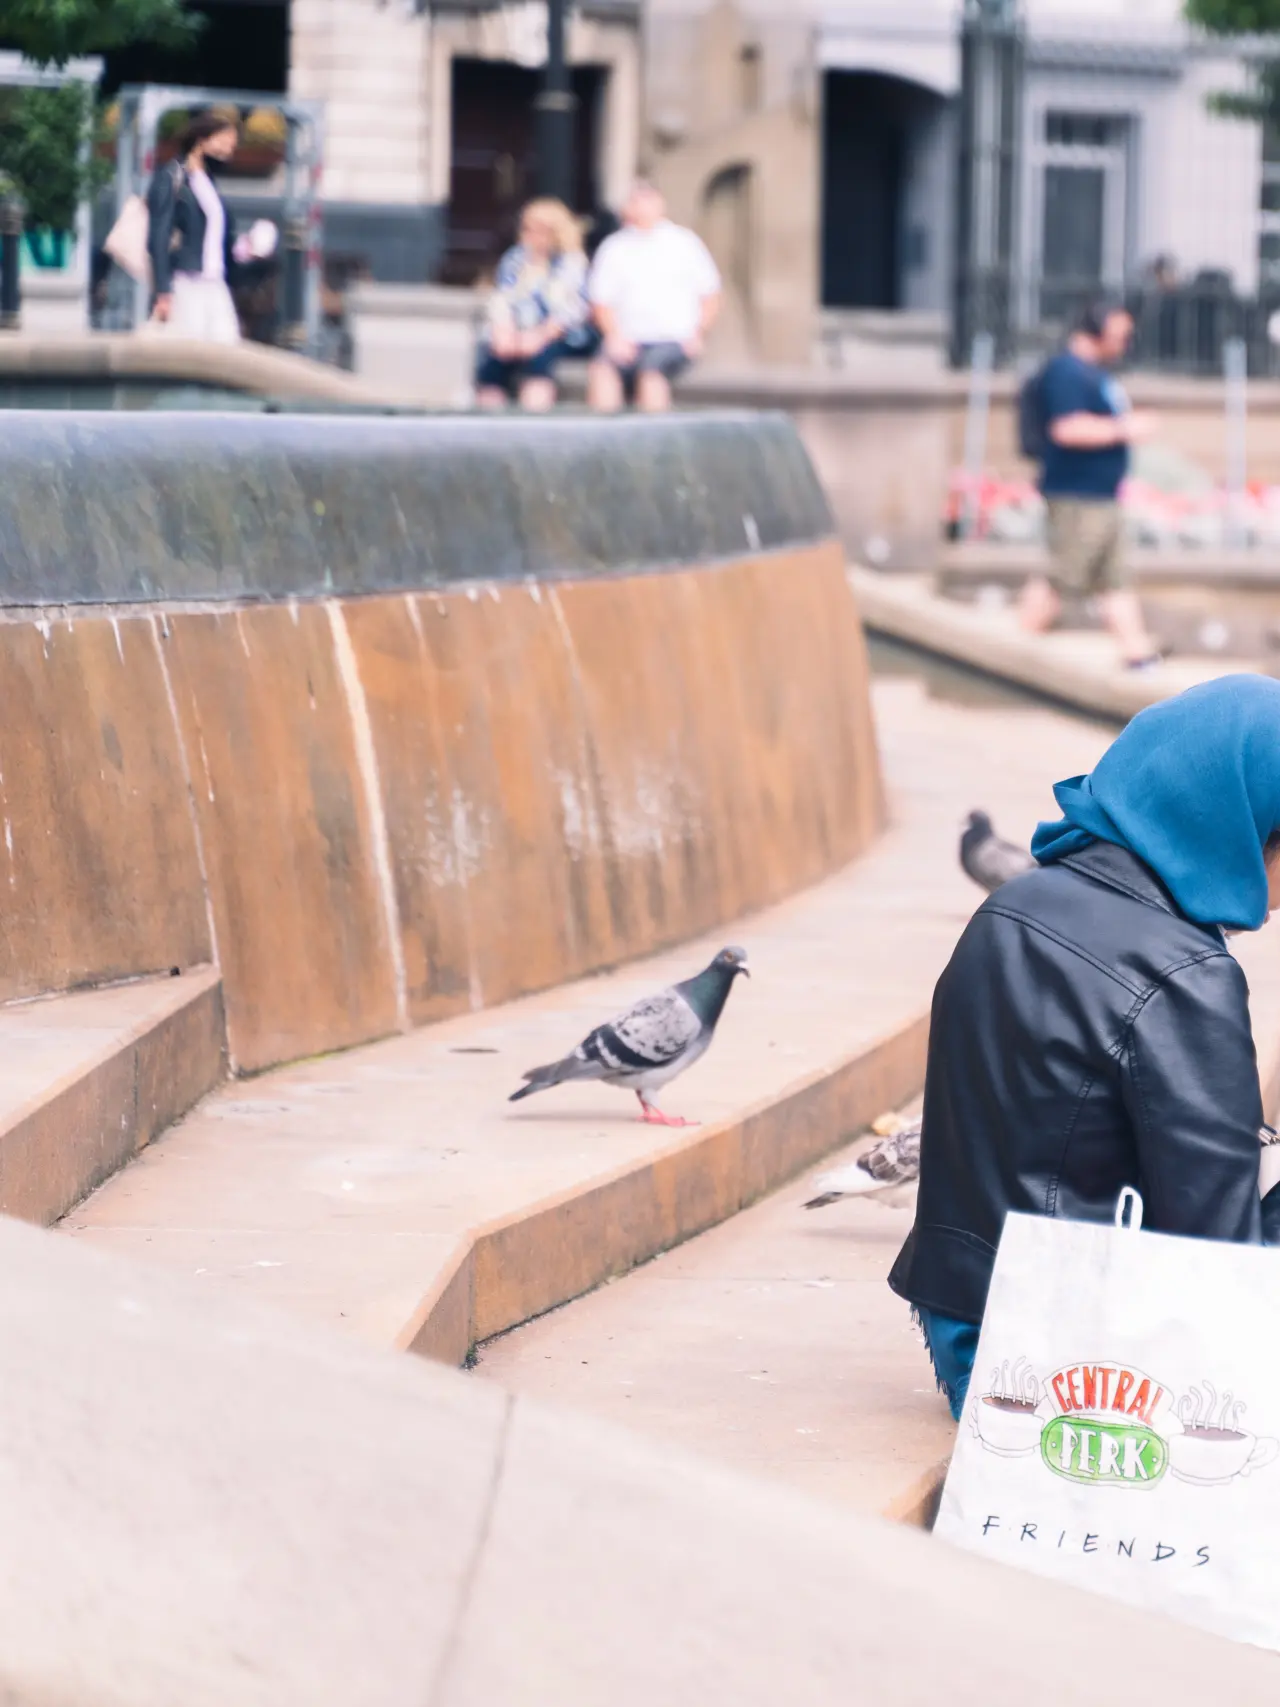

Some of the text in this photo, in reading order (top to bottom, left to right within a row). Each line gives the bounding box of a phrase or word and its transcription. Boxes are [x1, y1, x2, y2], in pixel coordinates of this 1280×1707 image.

[1051, 1365, 1164, 1427] CENTRAL
[1059, 1422, 1150, 1481] PERK
[982, 1515, 1211, 1567] FRIENDS
